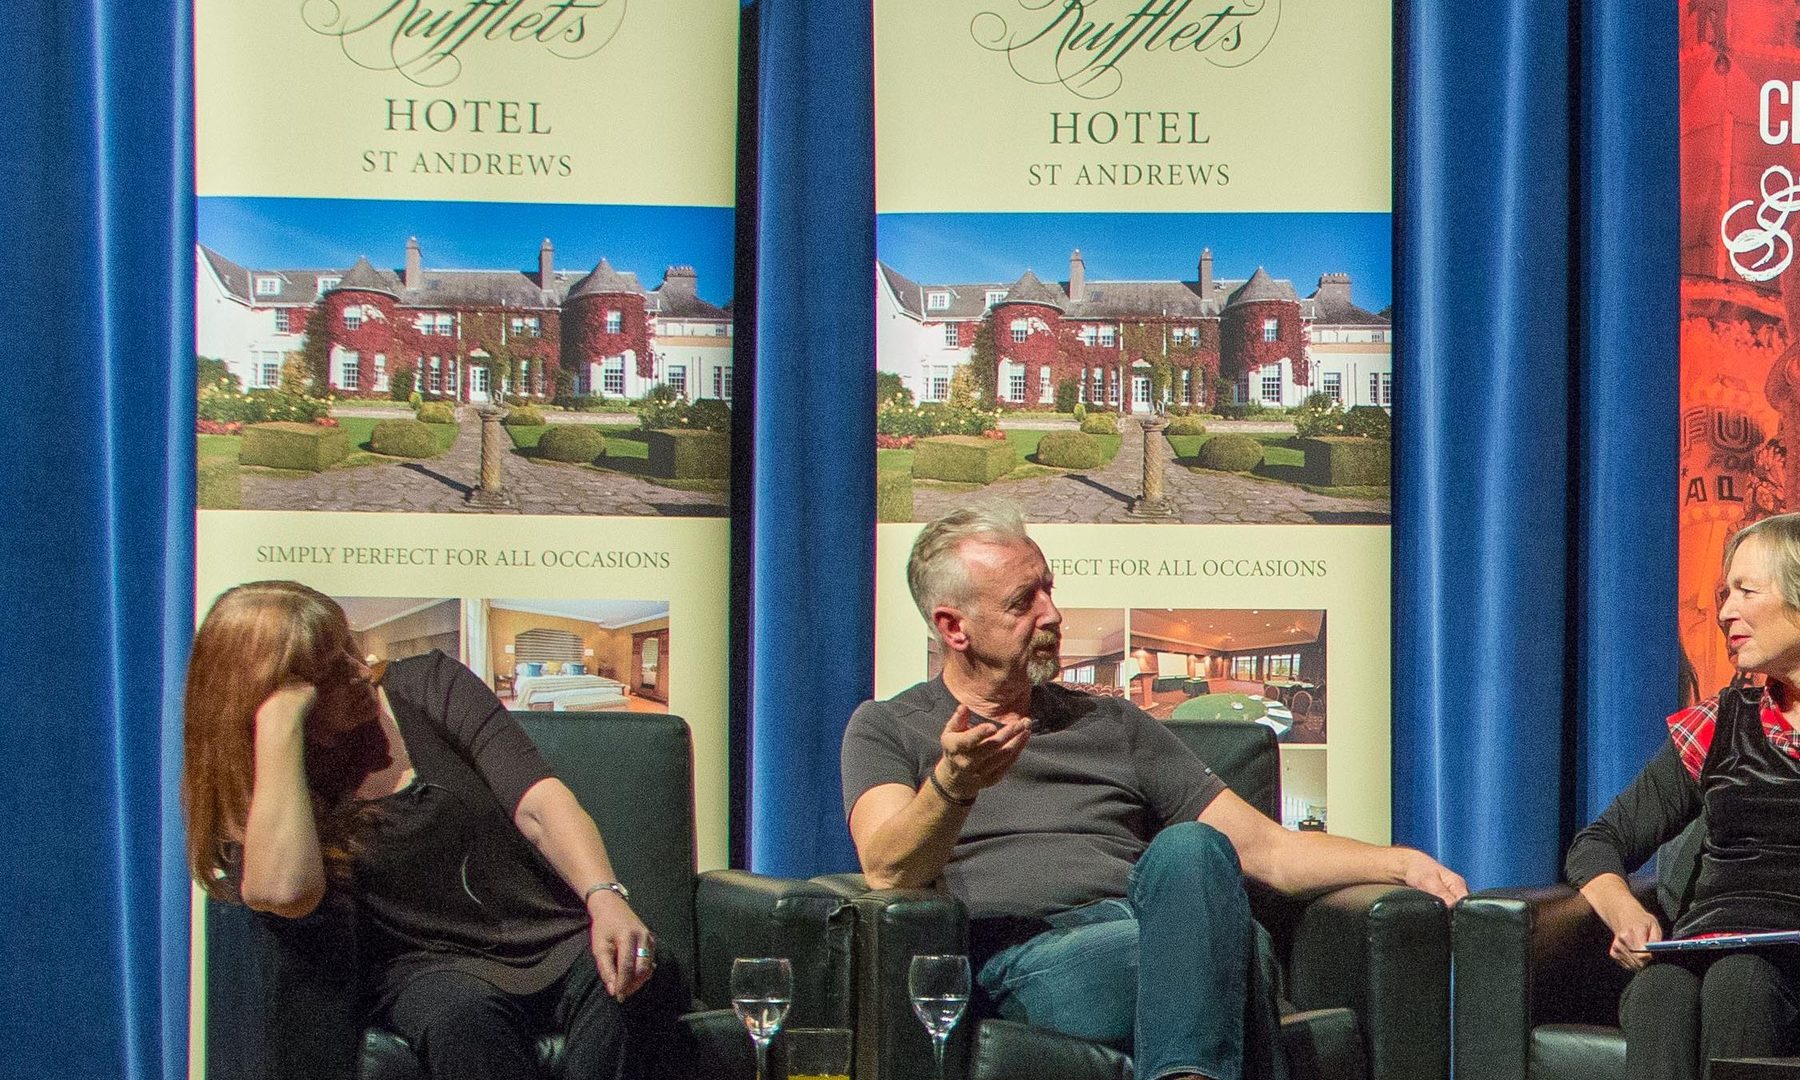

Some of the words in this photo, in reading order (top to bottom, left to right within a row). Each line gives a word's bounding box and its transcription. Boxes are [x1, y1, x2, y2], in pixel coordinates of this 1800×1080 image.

[384, 97, 552, 135] HOTEL
[1049, 111, 1211, 145] HOTEL
[361, 150, 398, 174] ST
[411, 152, 573, 177] ANDREWS
[1028, 163, 1063, 187] ST
[1075, 163, 1231, 187] ANDREWS
[256, 545, 337, 566] SIMPLY
[342, 546, 440, 567] PERFECT
[445, 549, 489, 568] FOR
[494, 549, 537, 568] ALL
[541, 550, 671, 570] OCCASIONS
[1049, 558, 1103, 577] FECT
[1109, 558, 1151, 577] FOR
[1158, 559, 1198, 577] ALL
[1202, 558, 1328, 578] OCCASIONS
